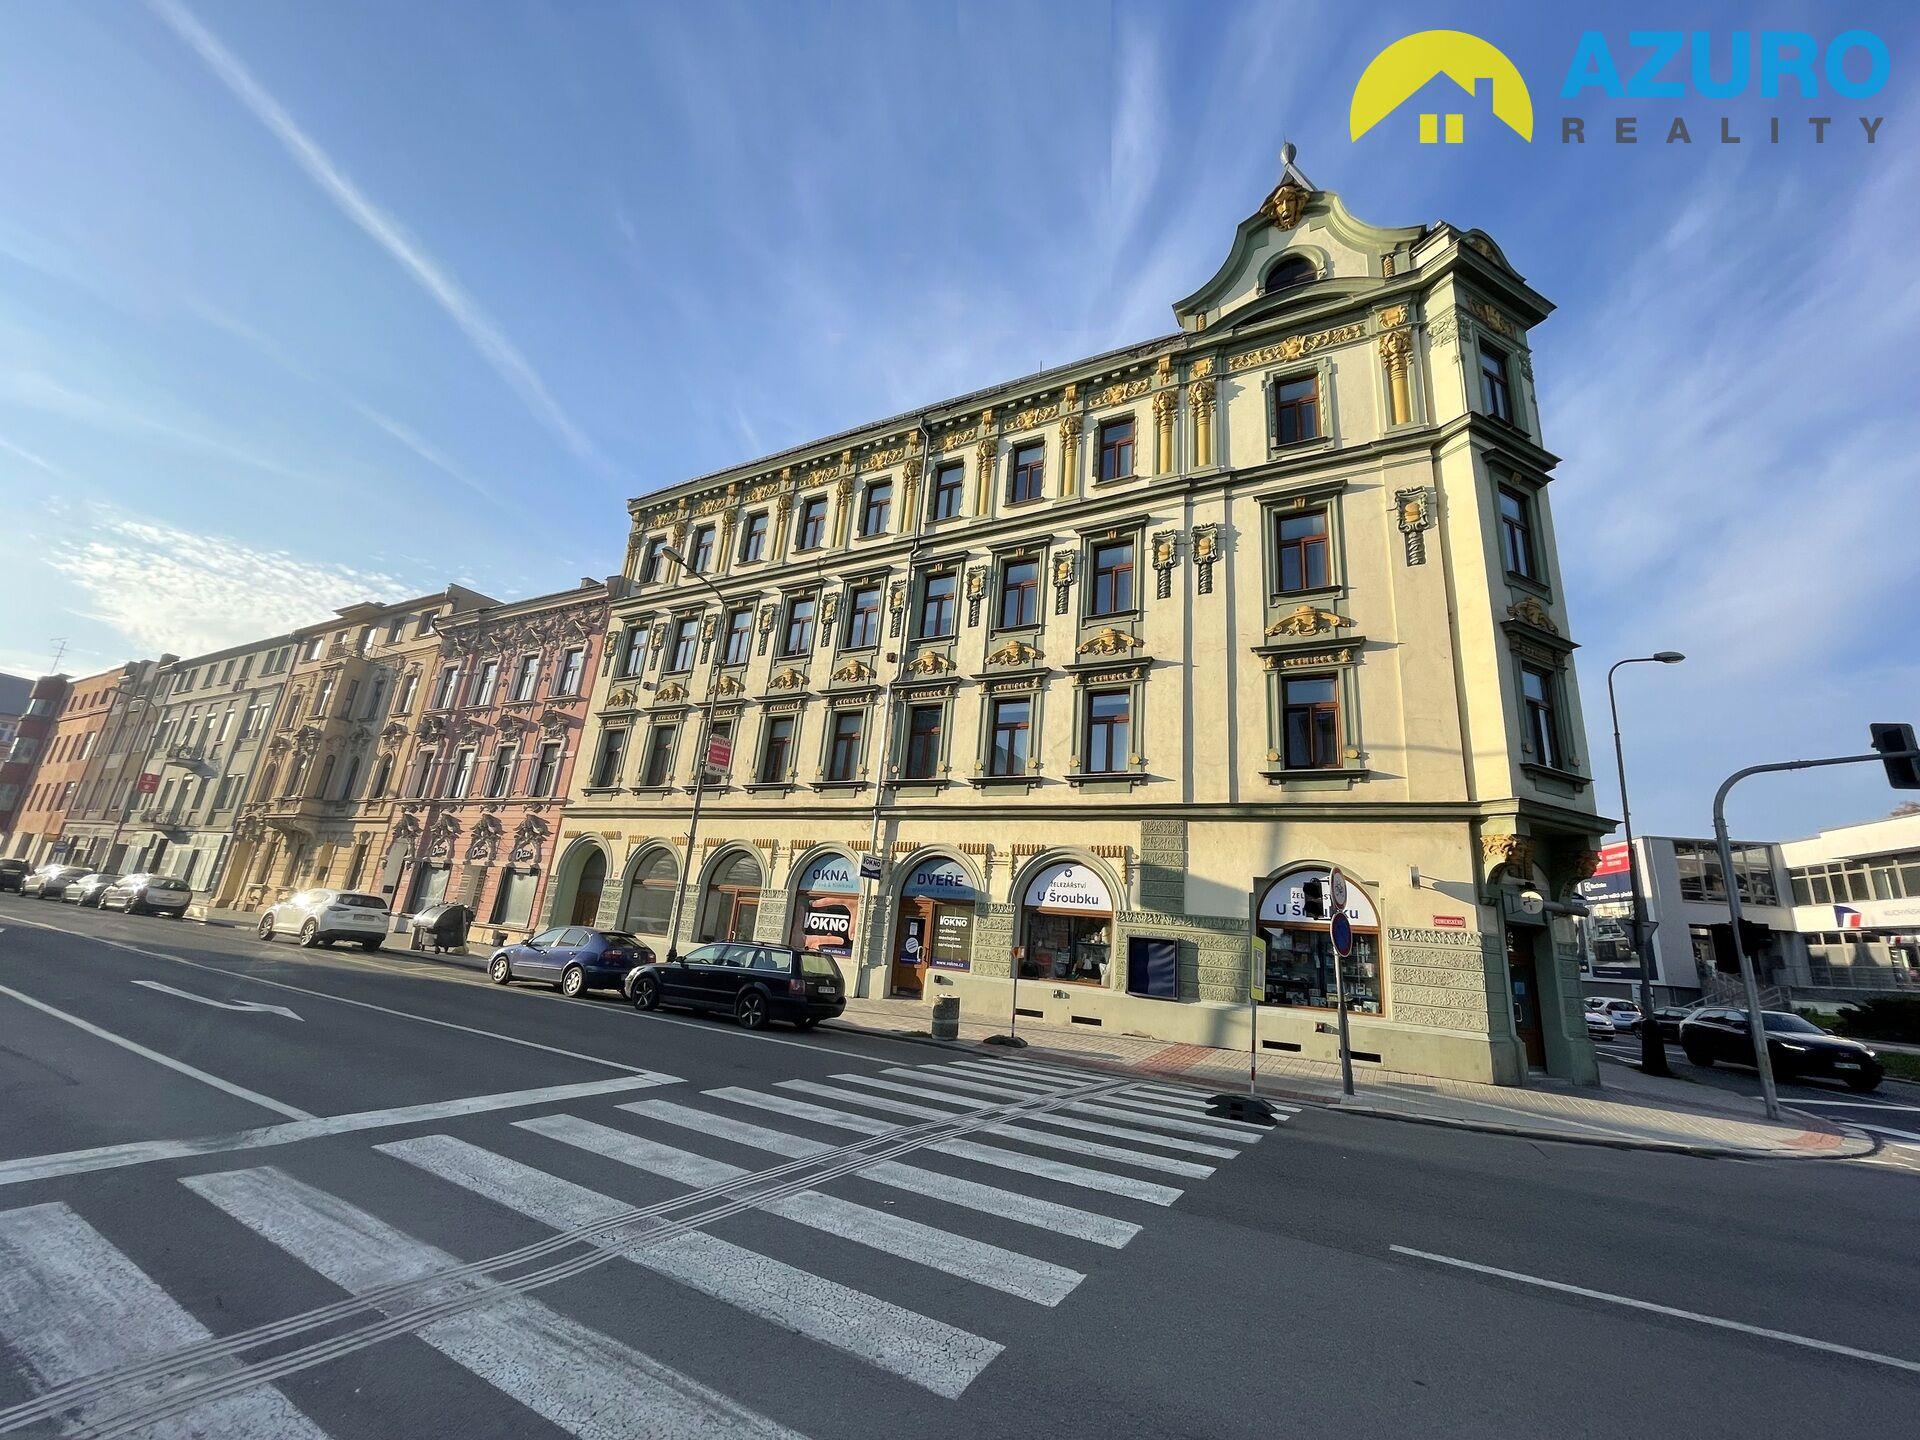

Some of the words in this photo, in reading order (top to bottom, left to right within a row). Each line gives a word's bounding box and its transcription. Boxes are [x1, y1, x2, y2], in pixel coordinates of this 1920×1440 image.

[812, 869, 849, 881] OKNA
[917, 871, 963, 886] DVEŘE
[1037, 891, 1045, 901] U
[1049, 889, 1099, 904] Šroubku
[1276, 904, 1286, 915] U
[804, 912, 849, 932] VOKNO
[940, 915, 968, 927] VOKNO
